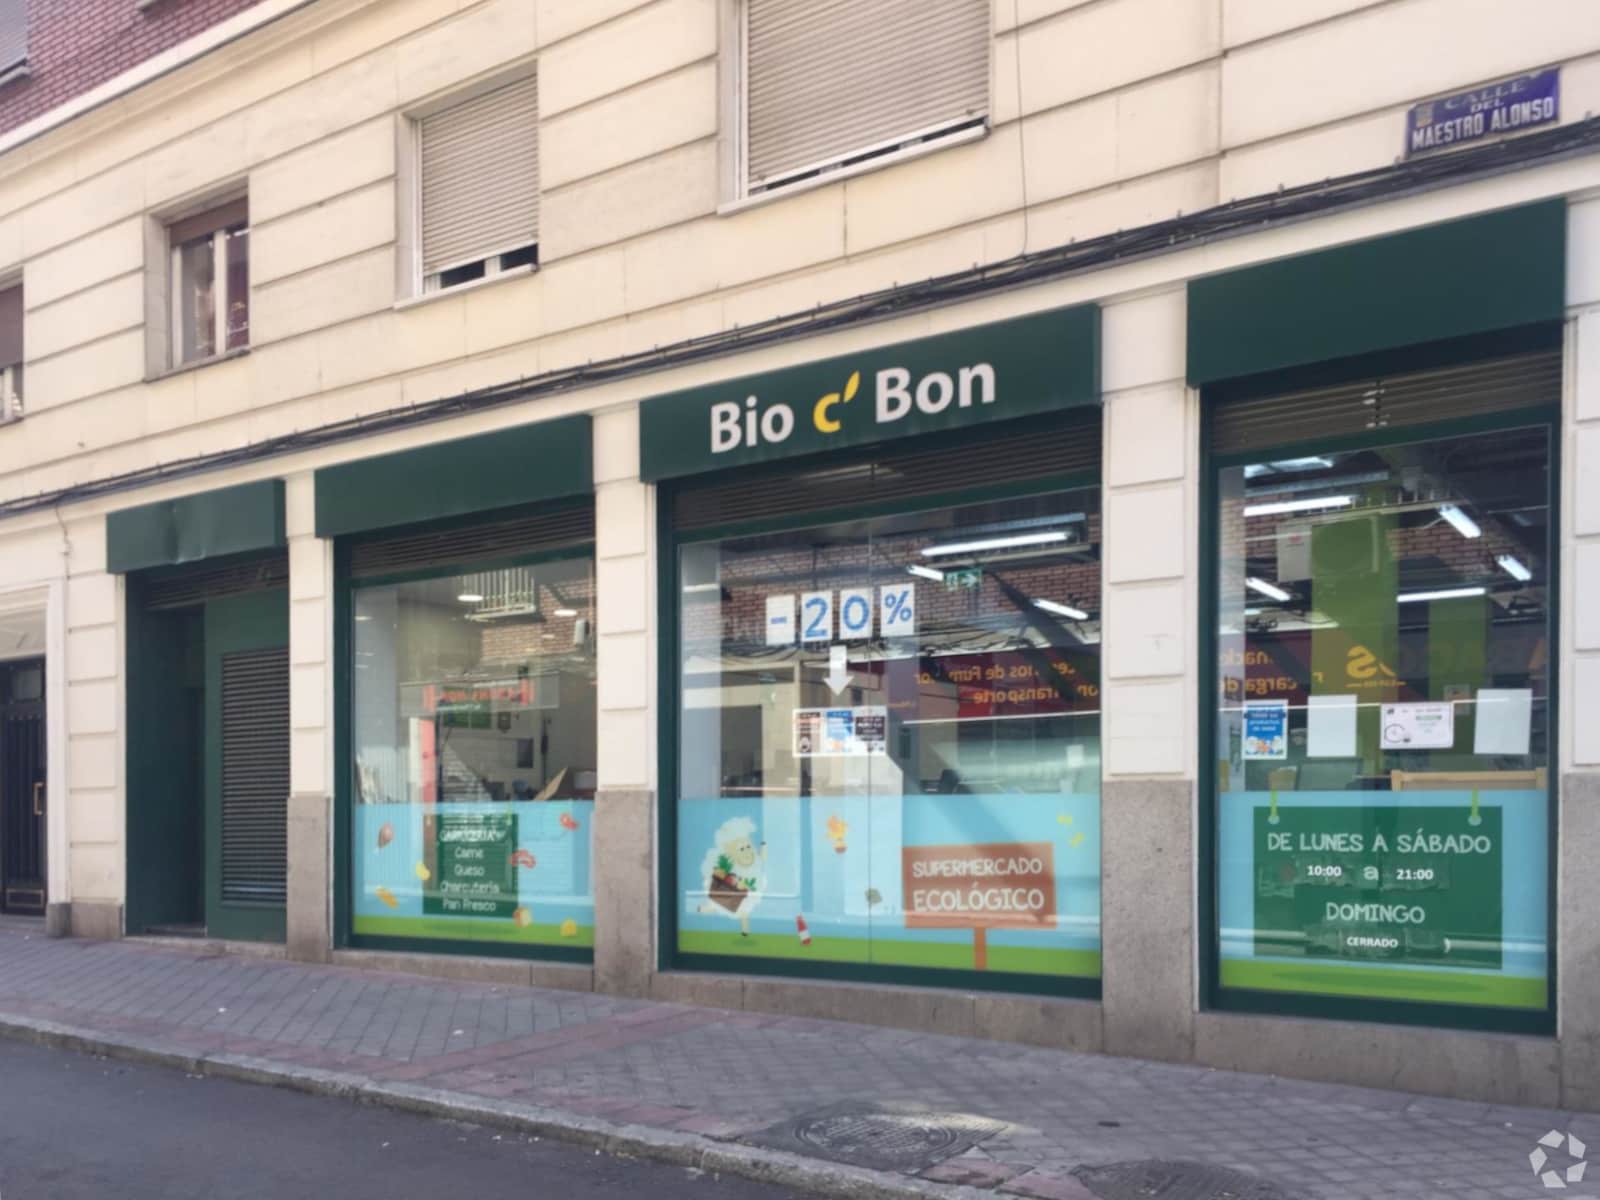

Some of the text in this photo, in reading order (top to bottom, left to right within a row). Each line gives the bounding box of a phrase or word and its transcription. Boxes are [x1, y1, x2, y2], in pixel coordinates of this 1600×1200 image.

[1471, 98, 1505, 113] DEL
[1411, 96, 1555, 150] MAESTRO ALONSO
[711, 395, 795, 453] Bio
[876, 362, 996, 423] Bon
[1267, 828, 1491, 853] DE LUNES A SÁBADO
[454, 864, 486, 877] Queso
[912, 857, 1043, 878] SUPERMERCADO
[1306, 865, 1434, 881] 10:00 a 21:00
[912, 880, 1045, 912] ECOLÓGICO
[1326, 902, 1426, 924] DOMINGO
[1346, 935, 1399, 949] CERRADO
